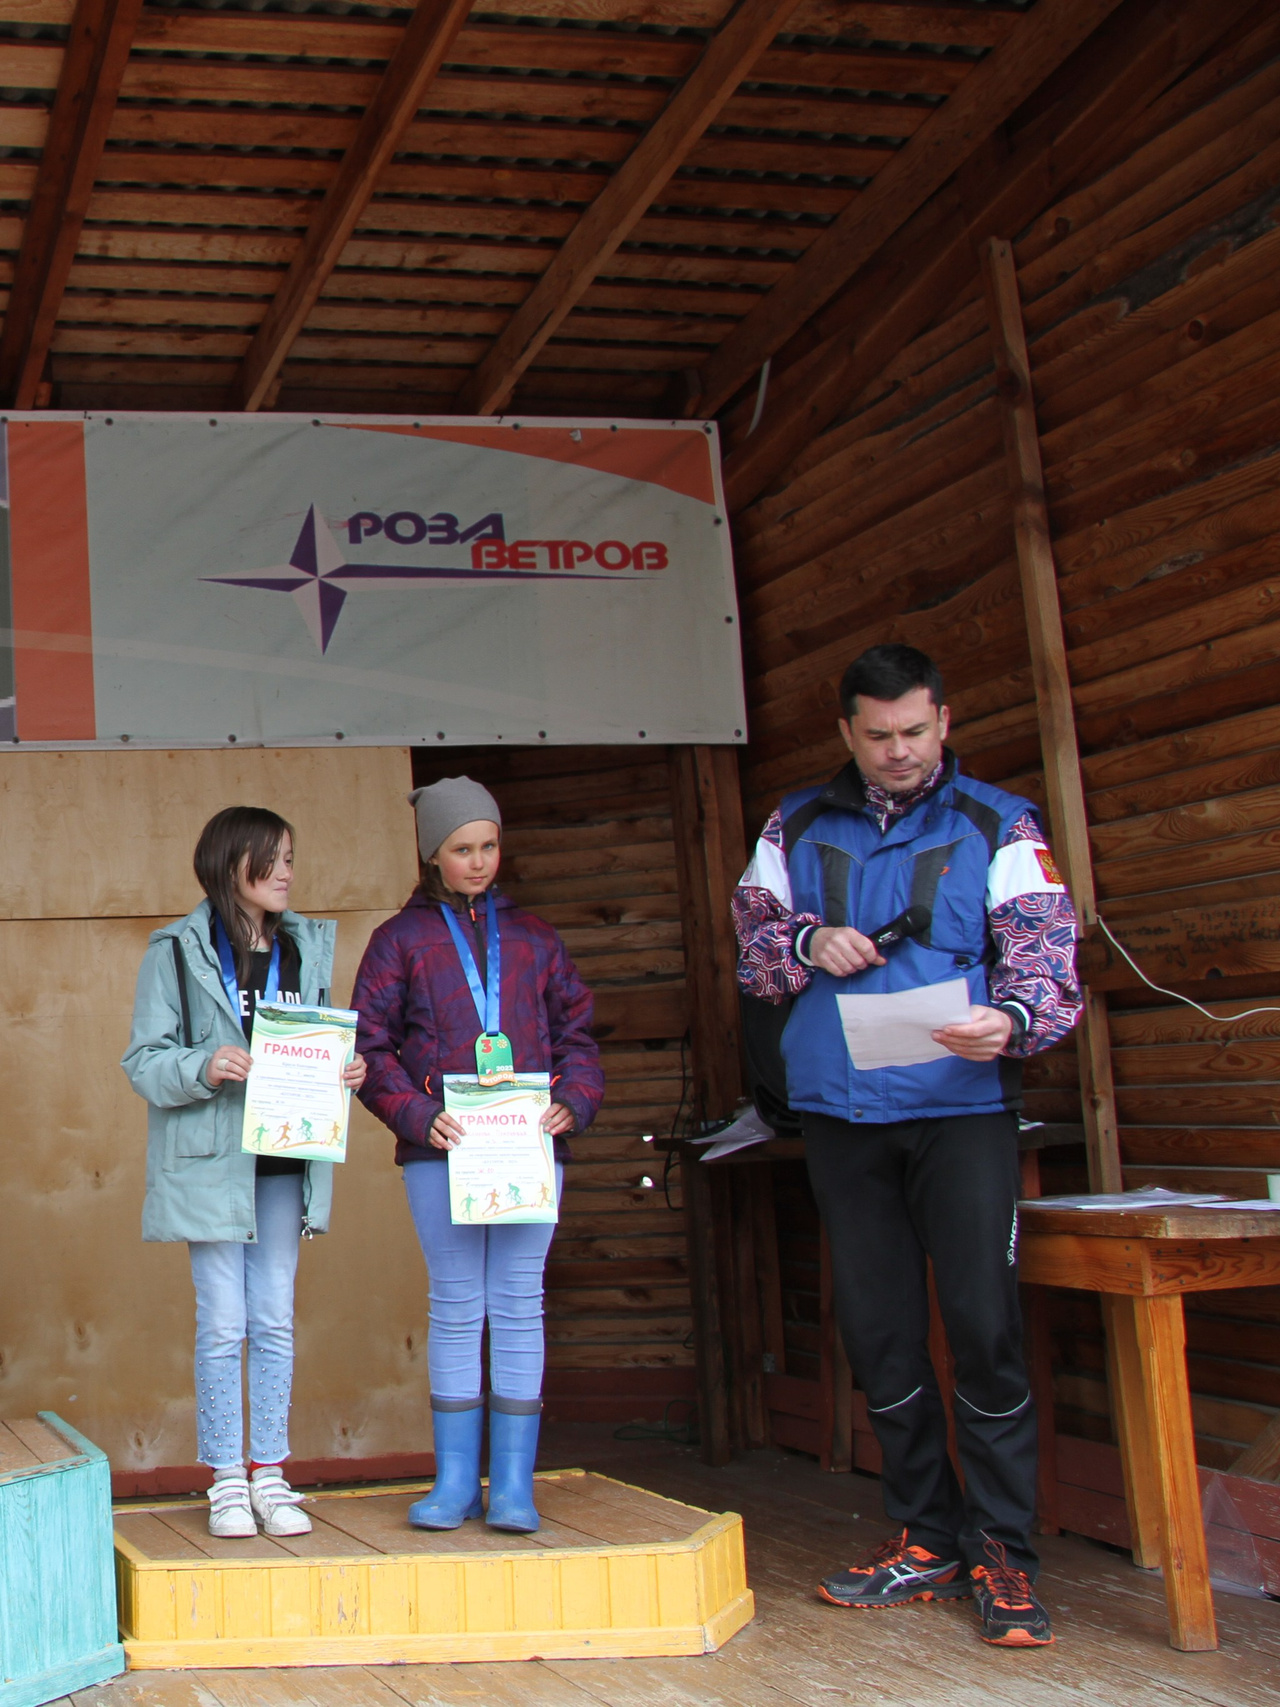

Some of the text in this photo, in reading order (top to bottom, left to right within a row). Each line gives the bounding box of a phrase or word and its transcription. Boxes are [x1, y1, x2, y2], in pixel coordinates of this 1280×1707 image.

[348, 511, 506, 545] РОЗА
[471, 539, 669, 570] ВЕТРОВ
[263, 1042, 331, 1061] ГРАМОТА
[481, 1039, 492, 1053] 3
[459, 1114, 528, 1126] ГРАМОТА
